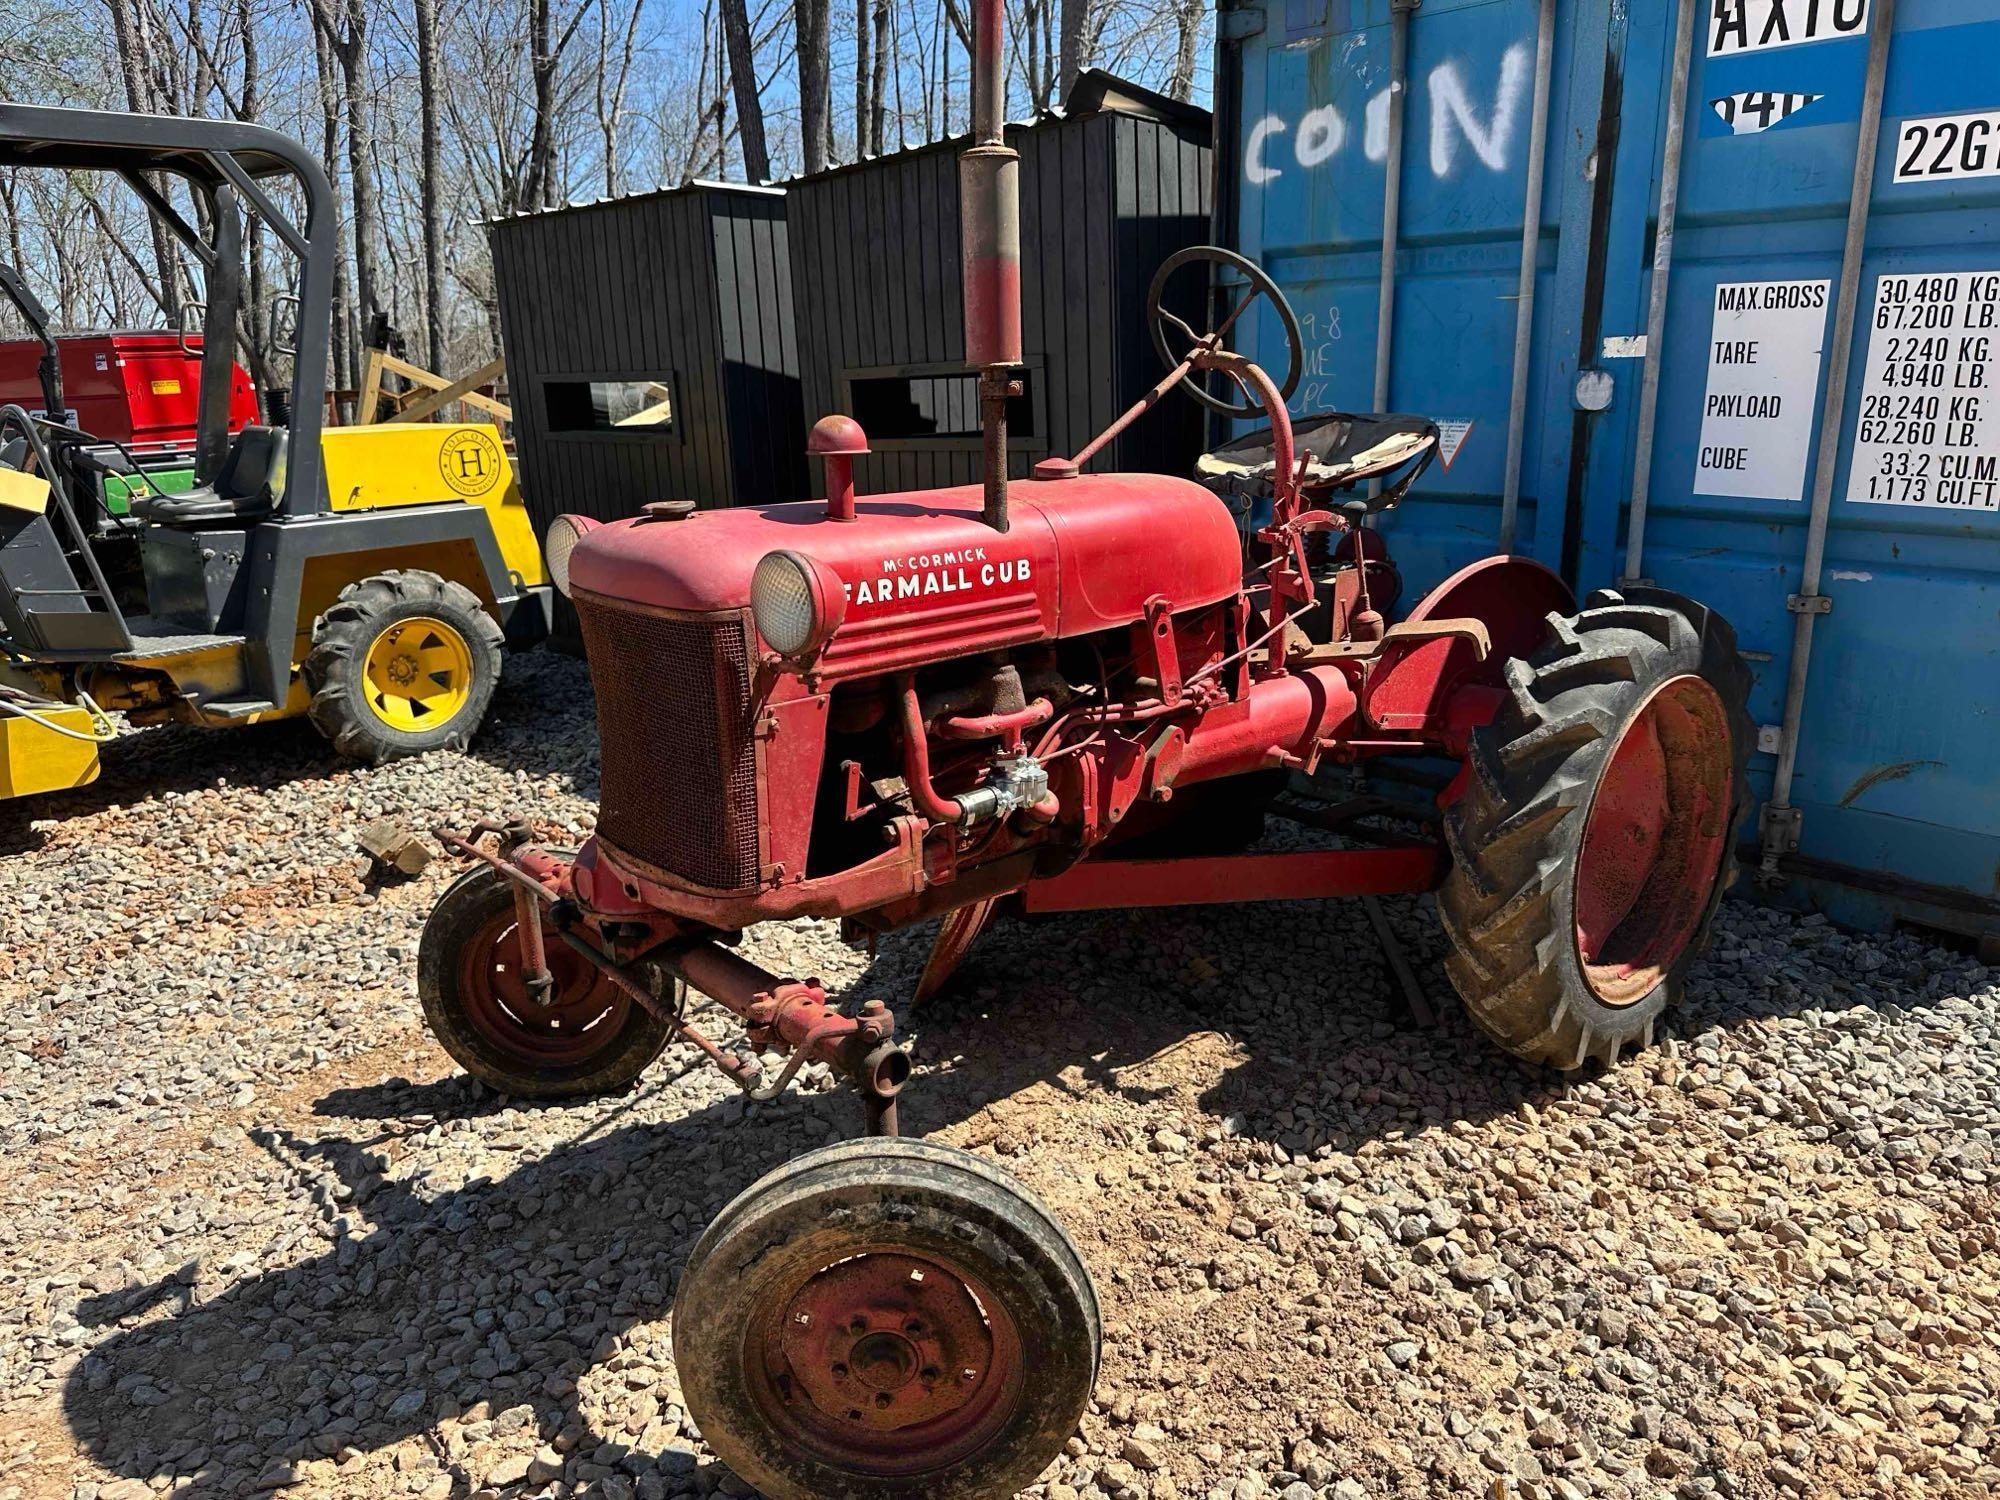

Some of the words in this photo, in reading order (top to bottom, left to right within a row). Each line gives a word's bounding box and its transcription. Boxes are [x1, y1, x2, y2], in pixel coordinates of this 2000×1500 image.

[1718, 285, 1825, 311] MAX.GROSS
[1880, 278, 1958, 304] 30,480
[1876, 304, 1954, 330] 67,200
[1963, 303, 1998, 328] LB.
[1715, 341, 1759, 364] TARE
[1886, 337, 1949, 362] 2,240
[1958, 337, 1993, 362] KG.
[1882, 363, 1945, 387] 4,940
[1954, 363, 1989, 388] LB.
[1706, 395, 1781, 418] PAYLOAD
[1863, 395, 1940, 420] 28,240
[1949, 396, 1983, 421] KG.
[1860, 420, 1936, 445] 62,260
[1944, 422, 1979, 447] LB.
[454, 448, 486, 478] H
[1701, 447, 1748, 470] CUBE
[1880, 452, 1931, 477] 33.2
[1940, 454, 1998, 481] CU.M.
[1869, 475, 1927, 502] 1,173
[1936, 479, 1997, 507] CU.FT.
[980, 558, 1032, 587] CUB
